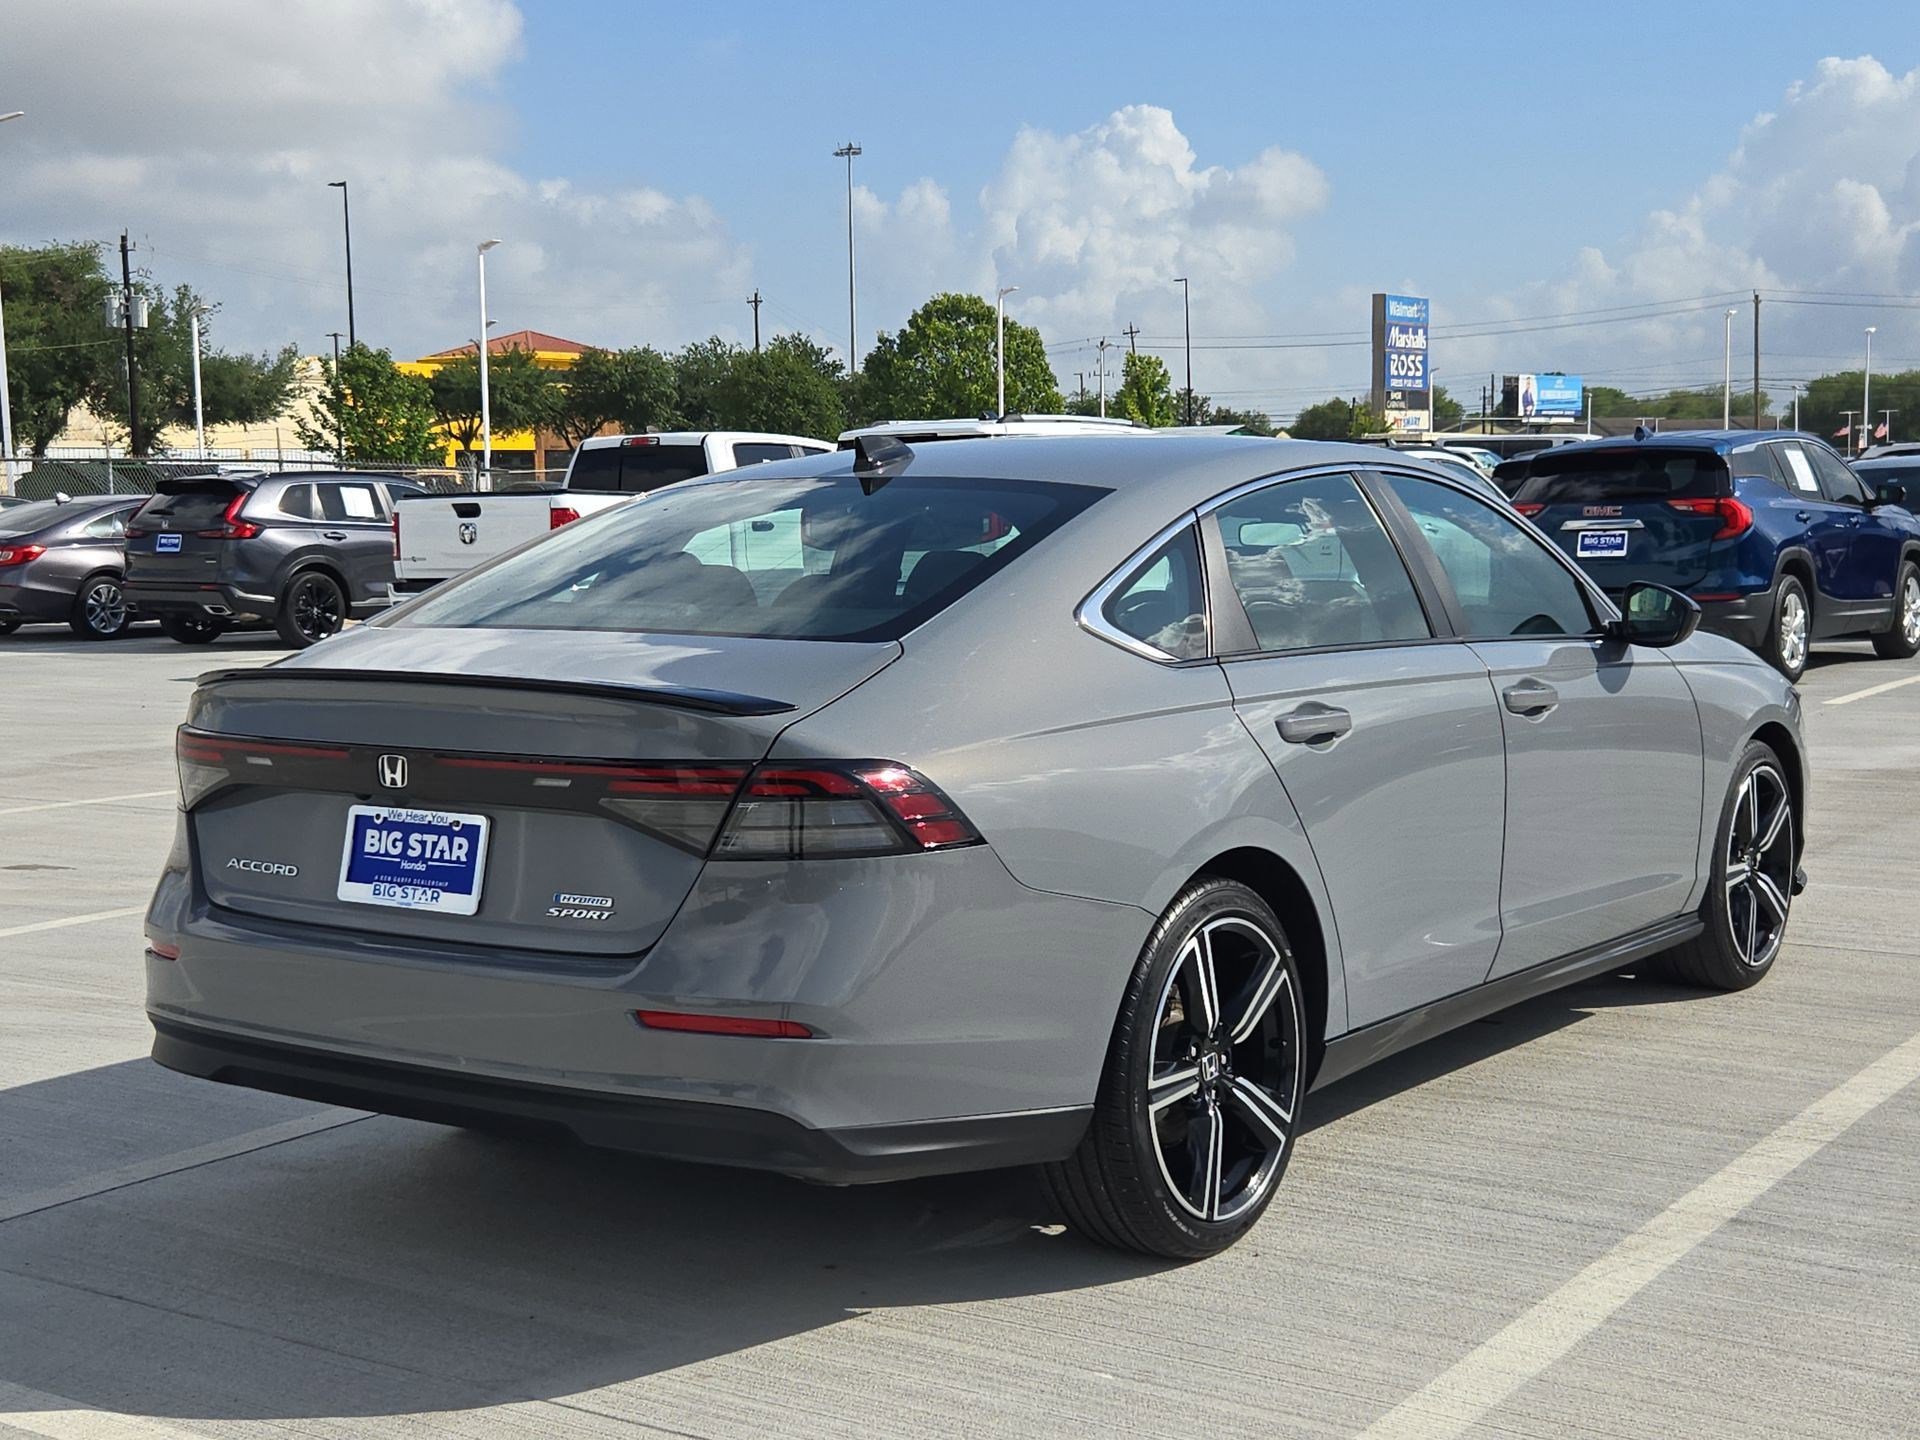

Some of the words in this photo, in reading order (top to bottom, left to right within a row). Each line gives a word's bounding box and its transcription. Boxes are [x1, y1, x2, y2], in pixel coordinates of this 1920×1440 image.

[1389, 299, 1417, 318] Walmart
[1388, 326, 1426, 349] Marshalls
[1390, 354, 1423, 377] ROSS
[1583, 506, 1623, 516] GMC
[1584, 537, 1599, 545] BIG
[1600, 537, 1622, 545] STAR
[388, 809, 402, 820] We
[405, 811, 428, 822] Hear
[430, 812, 449, 824] You
[364, 829, 403, 855] BIG
[407, 832, 469, 862] STAR
[226, 857, 298, 877] ACCORD
[400, 860, 427, 871] Honda
[372, 883, 397, 898] BIG
[400, 886, 441, 903] STAR
[561, 895, 609, 905] HYBRID
[546, 907, 615, 920] SPORT
